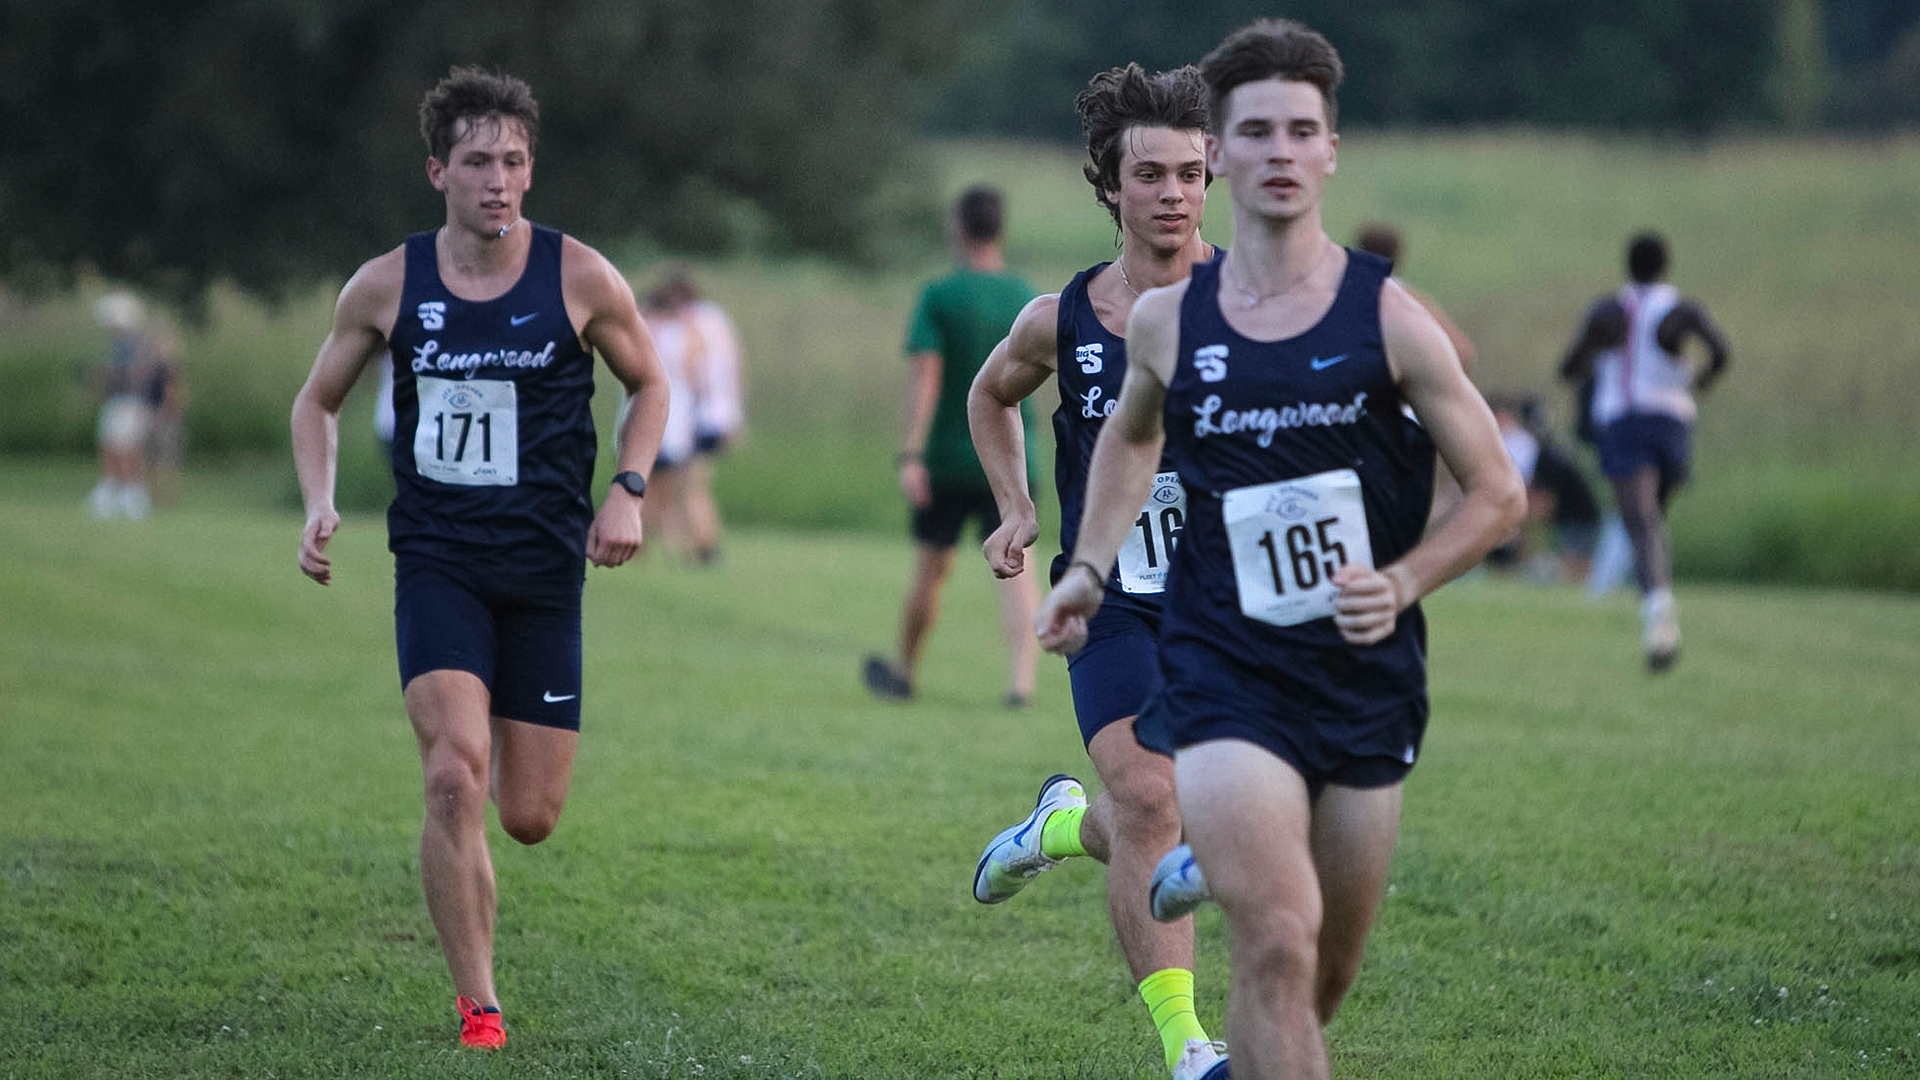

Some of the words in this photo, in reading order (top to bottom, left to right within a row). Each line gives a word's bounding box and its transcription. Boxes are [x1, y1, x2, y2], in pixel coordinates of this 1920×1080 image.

[412, 340, 555, 380] Longwood
[434, 411, 491, 462] 171
[1193, 392, 1367, 448] Longwood
[1157, 476, 1181, 484] OPEN
[1135, 507, 1184, 568] 16
[1259, 517, 1347, 597] 165
